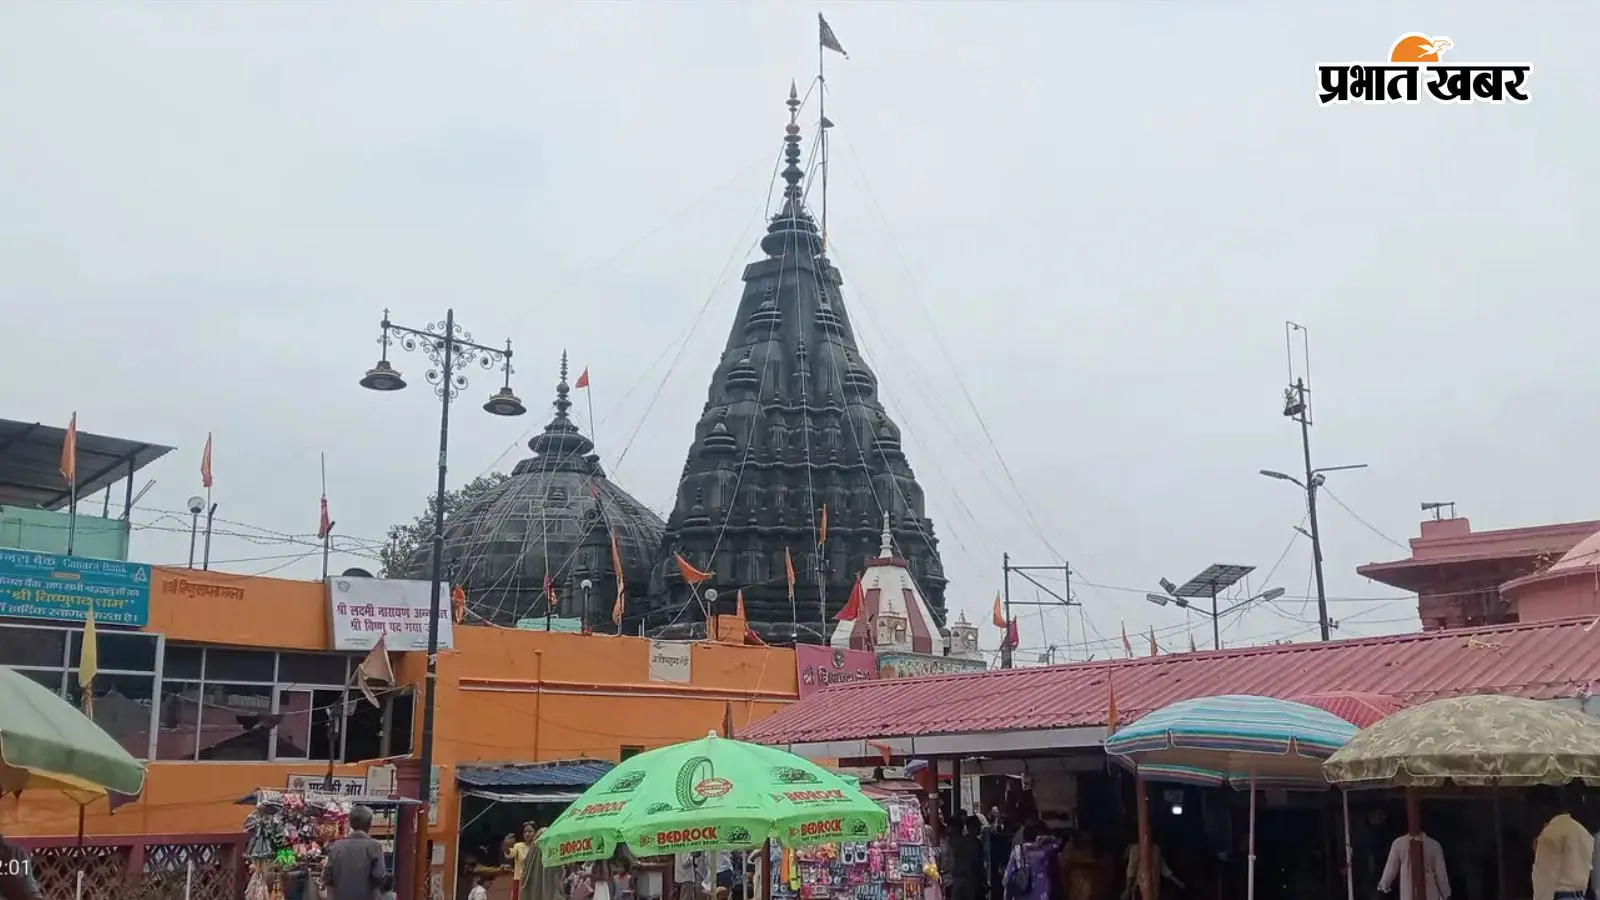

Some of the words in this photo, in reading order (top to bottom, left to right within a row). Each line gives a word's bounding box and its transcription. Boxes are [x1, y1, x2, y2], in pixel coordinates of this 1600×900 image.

[63, 558, 100, 571] Canara
[102, 561, 128, 573] Bank
[126, 589, 139, 597] का
[8, 603, 46, 616] हार्दिक
[336, 602, 347, 616] श्री
[377, 607, 410, 619] नारायण
[351, 618, 362, 632] श्री
[365, 620, 387, 634] विष्णु
[389, 622, 402, 632] पद
[404, 623, 422, 633] गया
[783, 789, 844, 801] BEDROCK
[581, 800, 626, 815] BEDROCK
[801, 819, 842, 836] BEDROCK
[657, 826, 718, 845] BEDROCK
[559, 836, 593, 856] BEDROCK
